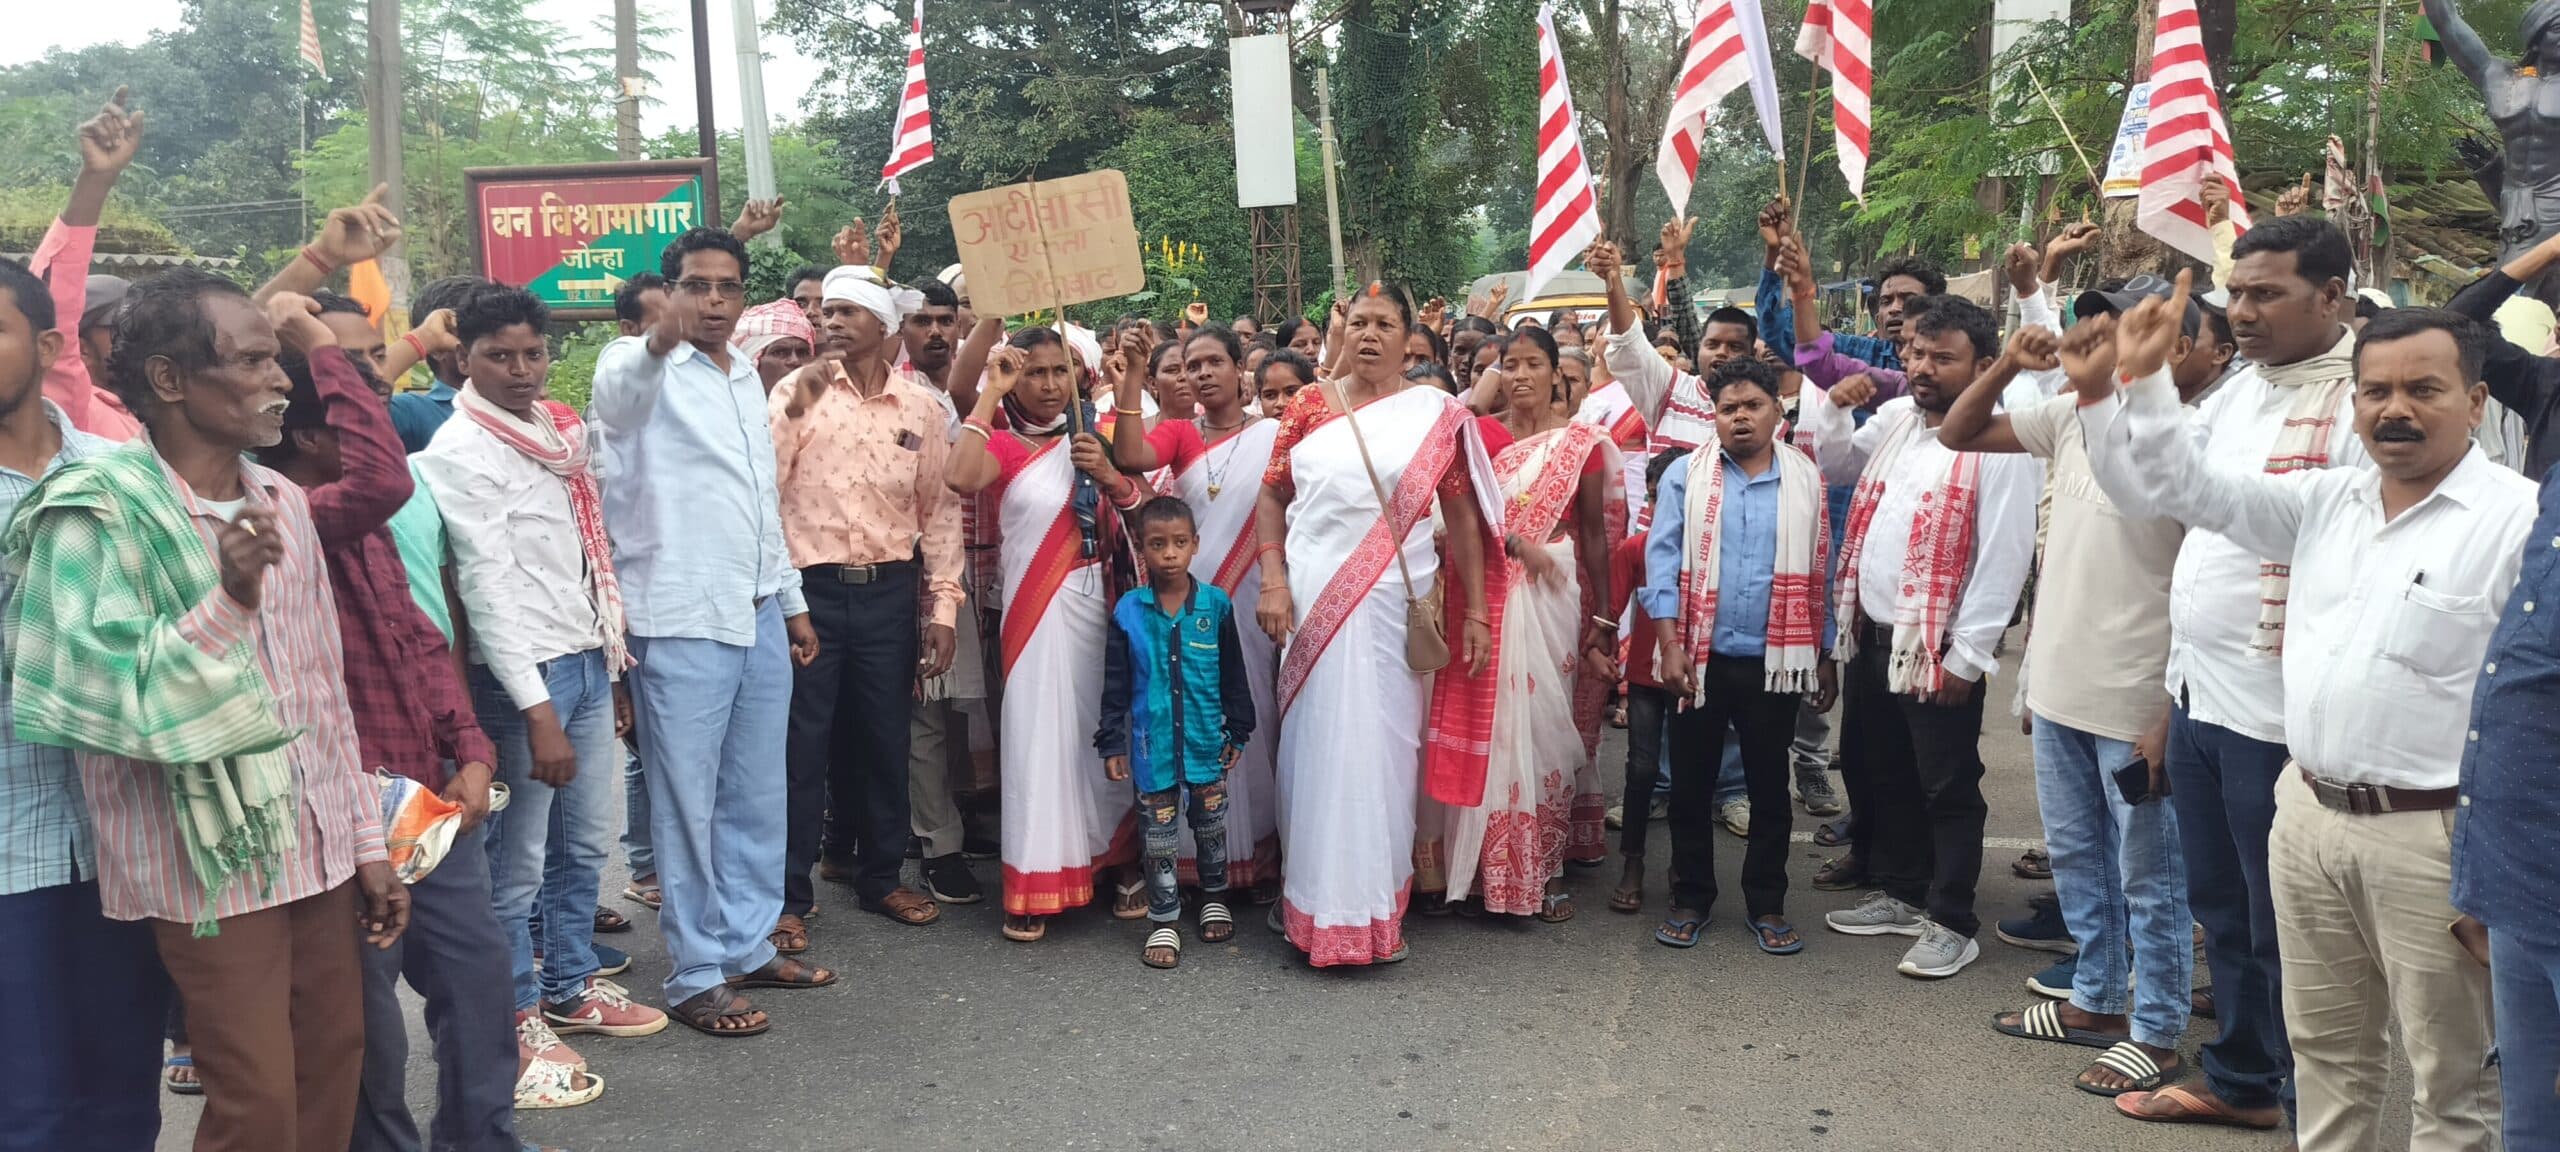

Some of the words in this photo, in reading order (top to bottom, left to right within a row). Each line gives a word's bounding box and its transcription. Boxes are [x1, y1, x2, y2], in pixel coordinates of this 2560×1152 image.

[490, 206, 533, 238] वन
[540, 191, 693, 238] विश्रामागार
[560, 240, 625, 270] जोन्हा
[1704, 493, 1721, 525] जोहार
[1699, 530, 1713, 562] जोहार
